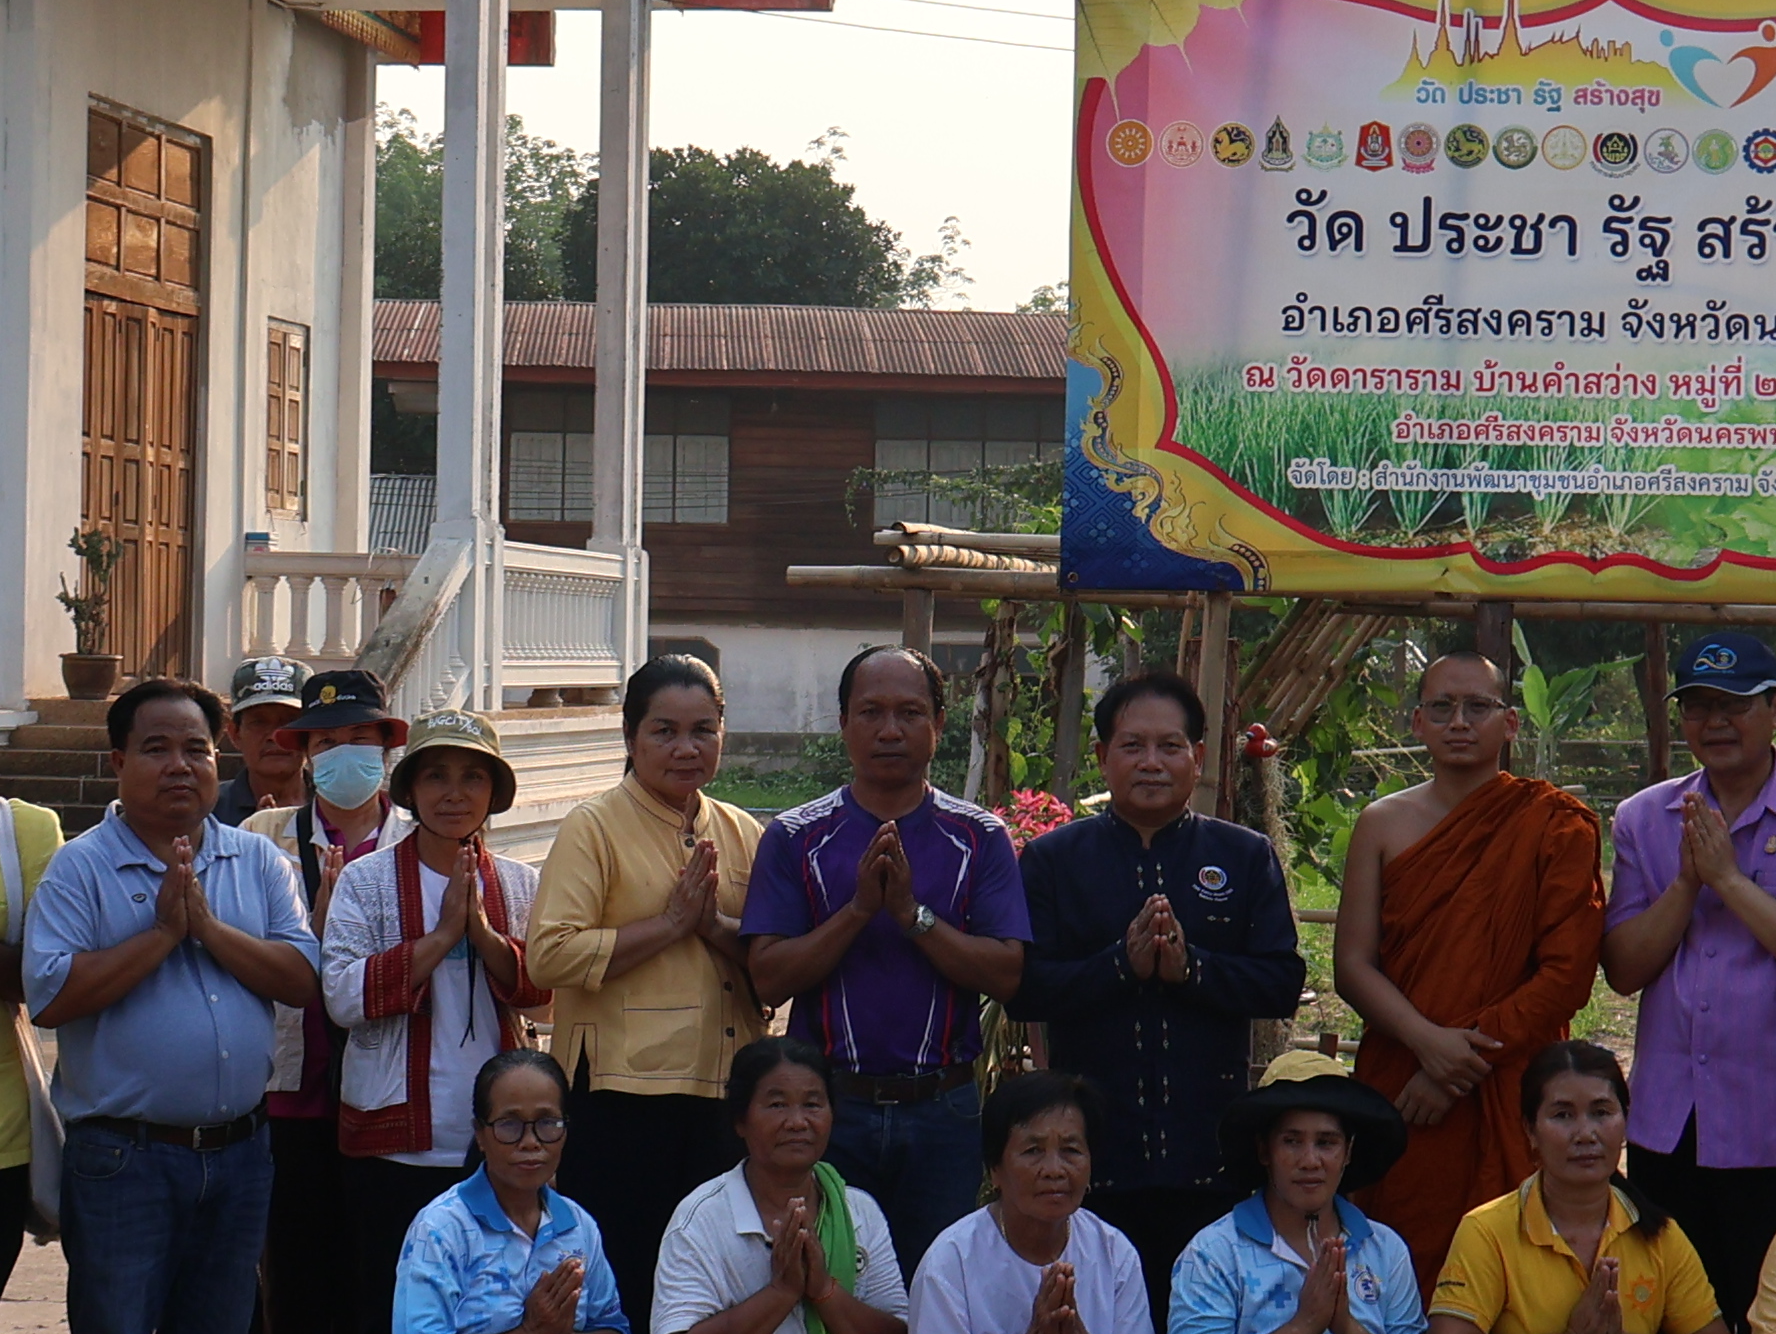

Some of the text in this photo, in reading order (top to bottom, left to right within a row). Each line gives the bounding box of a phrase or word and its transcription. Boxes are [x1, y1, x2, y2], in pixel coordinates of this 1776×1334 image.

[1415, 80, 1661, 114] วัด ประชา รัฐ สร้างสุข
[1285, 187, 1365, 253] วัด
[1388, 195, 1578, 257] ประชา
[1602, 193, 1673, 283] รัฐ
[1280, 291, 1606, 339] อำเภอศรีสงคราม
[1245, 364, 1275, 389] ณ
[1286, 354, 1462, 393] วัดดาราราม
[1474, 359, 1658, 397] บ้านคำสว่าง
[1669, 356, 1743, 409] หมู่ที่
[1394, 413, 1601, 445] อำเภอศรีสงคราม
[1290, 460, 1354, 487] จัดโดย
[1374, 461, 1750, 499] สำนักงานพัฒนาชุมชนอำเภอศรีสงคราม
[253, 679, 294, 692] adidas
